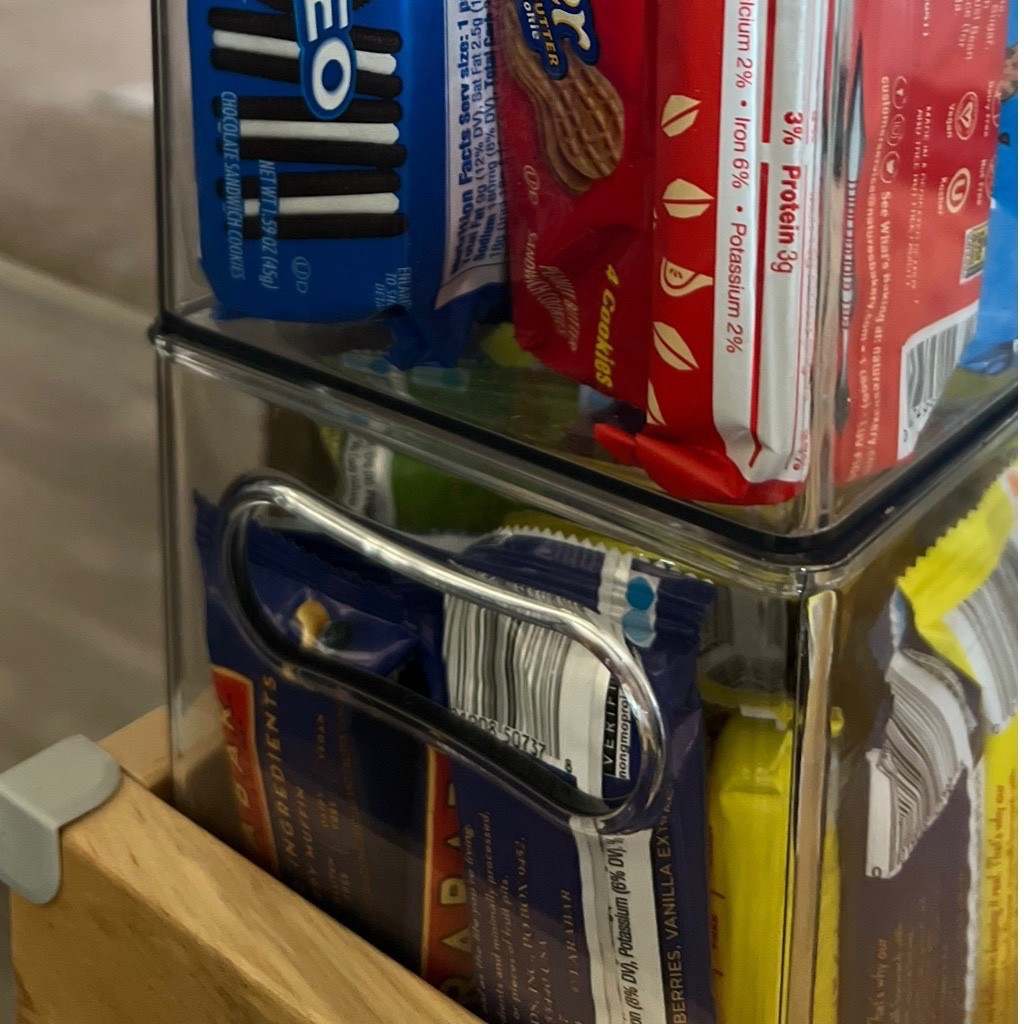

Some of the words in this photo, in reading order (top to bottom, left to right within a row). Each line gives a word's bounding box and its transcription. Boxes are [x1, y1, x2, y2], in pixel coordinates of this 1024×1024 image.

[457, 18, 470, 31] 1
[468, 16, 485, 50] 2.5g
[457, 33, 470, 79] size:
[734, 54, 753, 89] 2%
[459, 82, 472, 126] Serv
[946, 103, 956, 140] Vegan
[221, 91, 240, 160] CHOCOLATE
[732, 118, 747, 154] Iron
[782, 111, 804, 145] 3%
[259, 160, 276, 186] NET
[458, 129, 473, 188] Facts
[730, 160, 750, 189] 6%
[224, 161, 244, 225] SANDWICH
[261, 188, 277, 210] WT
[776, 165, 800, 244] Protein
[881, 190, 893, 218] See
[261, 212, 278, 238] 1.59
[227, 227, 246, 280] COOKIES
[261, 240, 278, 255] OZ
[770, 250, 798, 275] 3g
[881, 221, 892, 270] What's
[259, 256, 279, 289] (45g)
[606, 264, 619, 285] 4
[725, 222, 747, 318] Potassium
[595, 288, 617, 389] Cookies
[725, 322, 744, 354] 2%
[503, 726, 547, 758] 50737
[565, 759, 573, 773] 8
[610, 869, 632, 895] (6%
[661, 863, 678, 941] VANILLA
[614, 897, 634, 958] Potassium
[619, 959, 639, 984] DV),
[666, 944, 687, 1024] BERRIES,
[624, 986, 644, 1010] (8%
